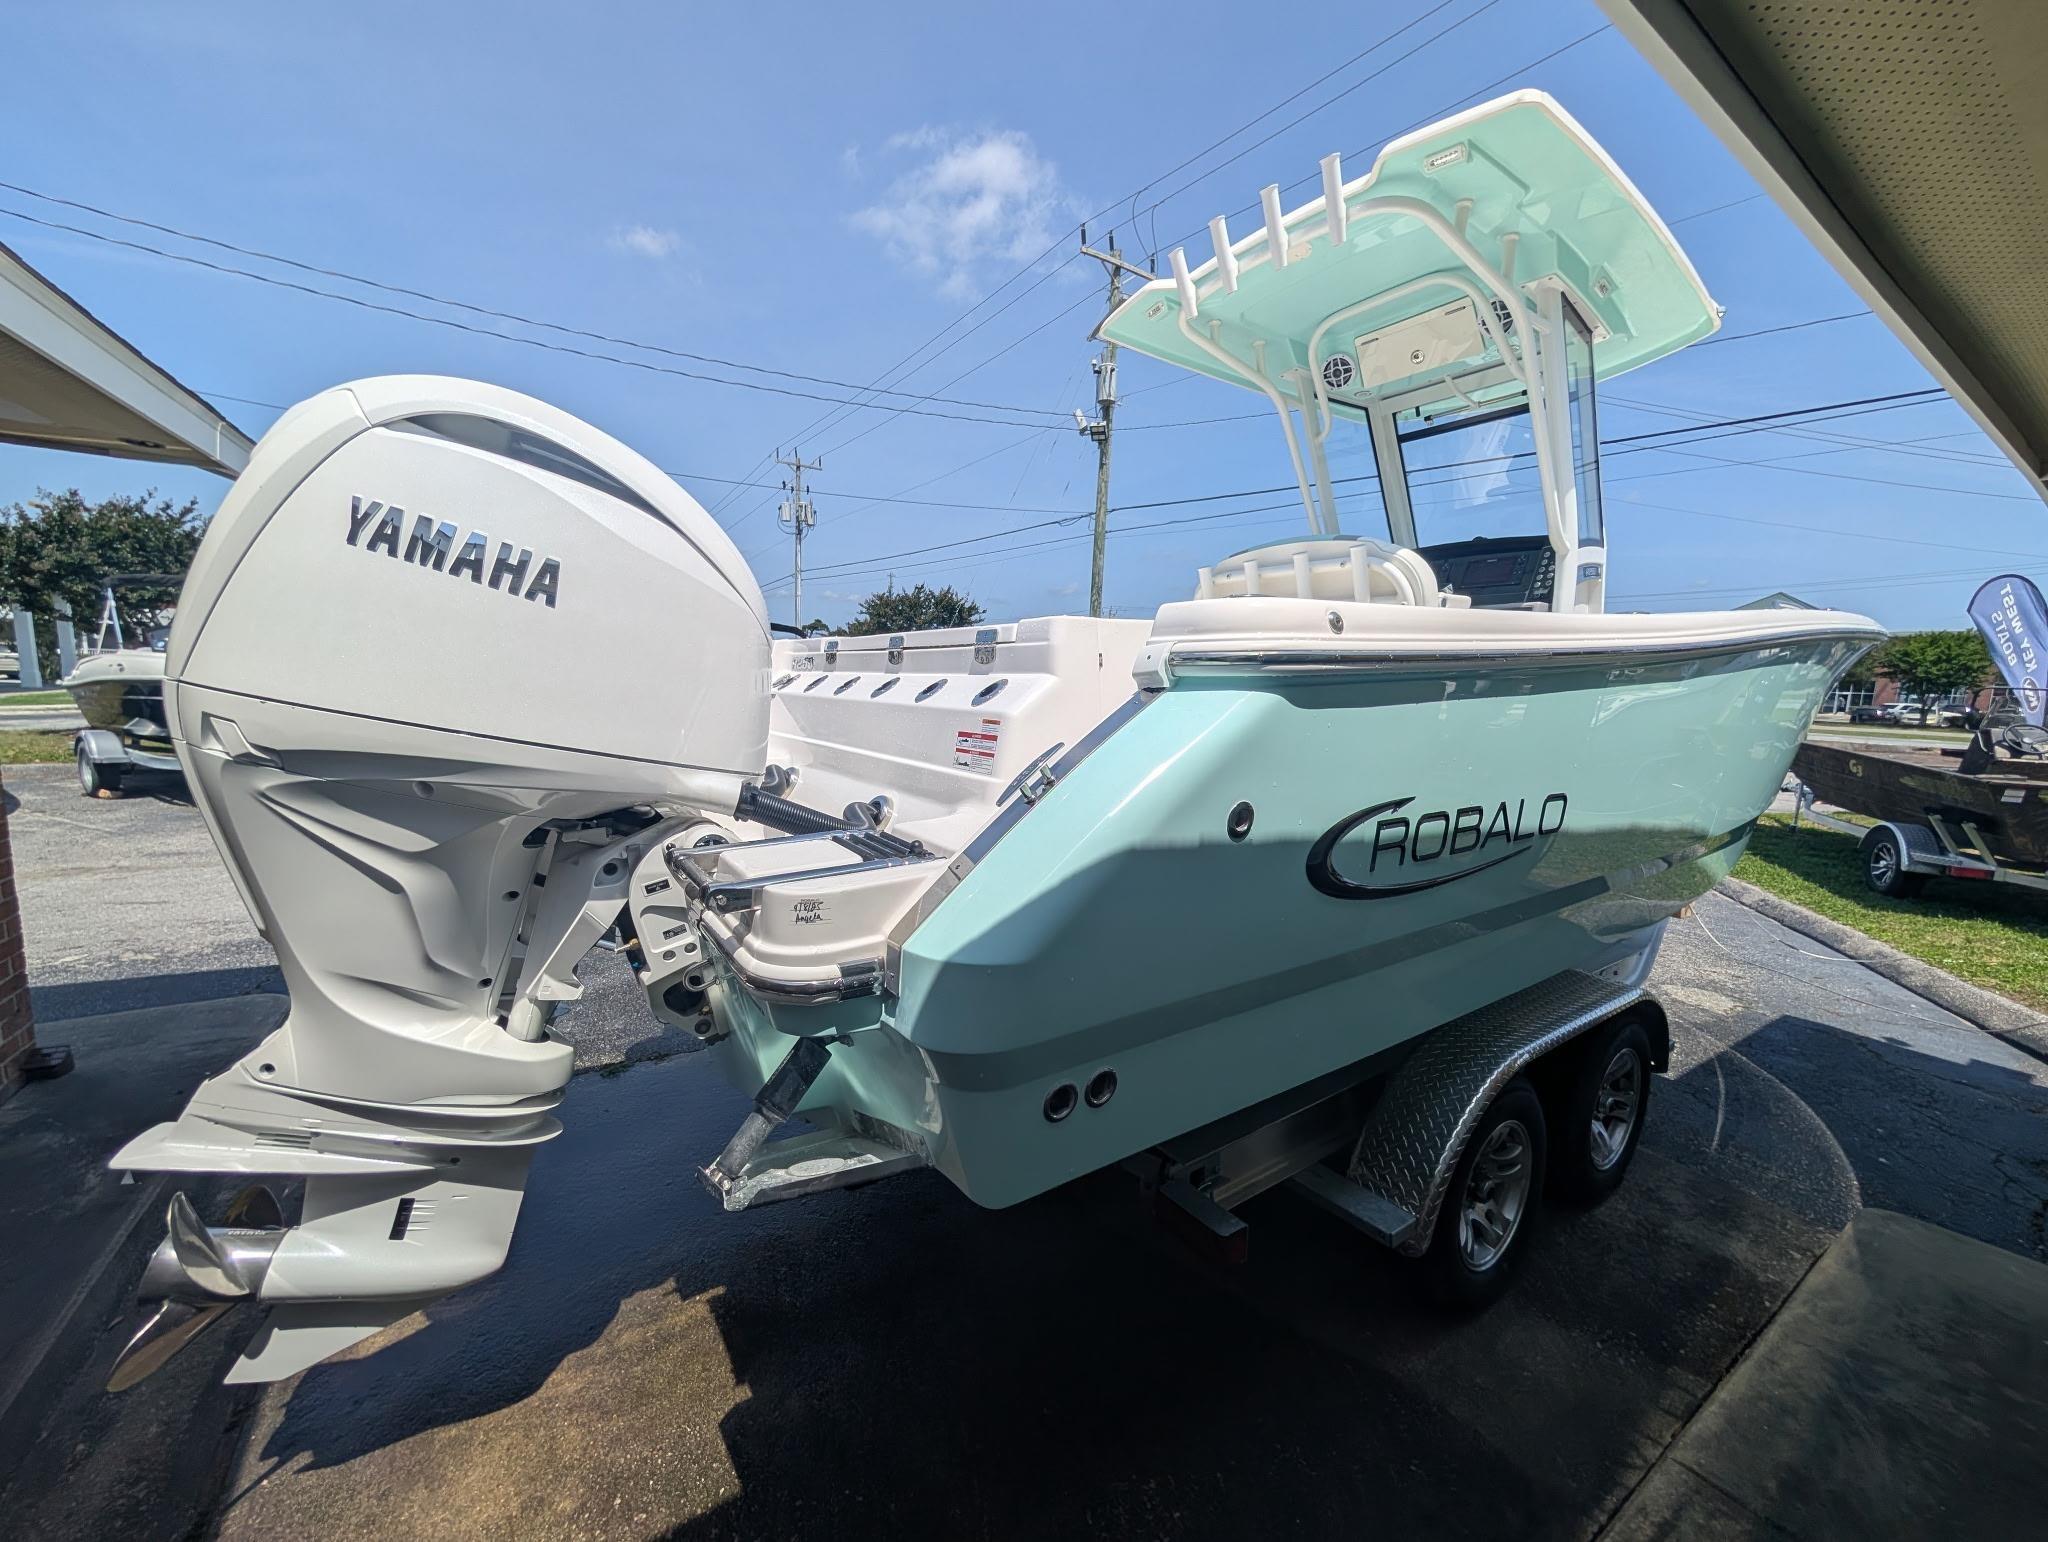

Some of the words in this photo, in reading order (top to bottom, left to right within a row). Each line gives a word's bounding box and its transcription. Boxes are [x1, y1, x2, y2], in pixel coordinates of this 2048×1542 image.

[346, 495, 561, 609] YAMAHA
[1849, 759, 1863, 777] G3
[1369, 793, 1568, 873] ROBALO
